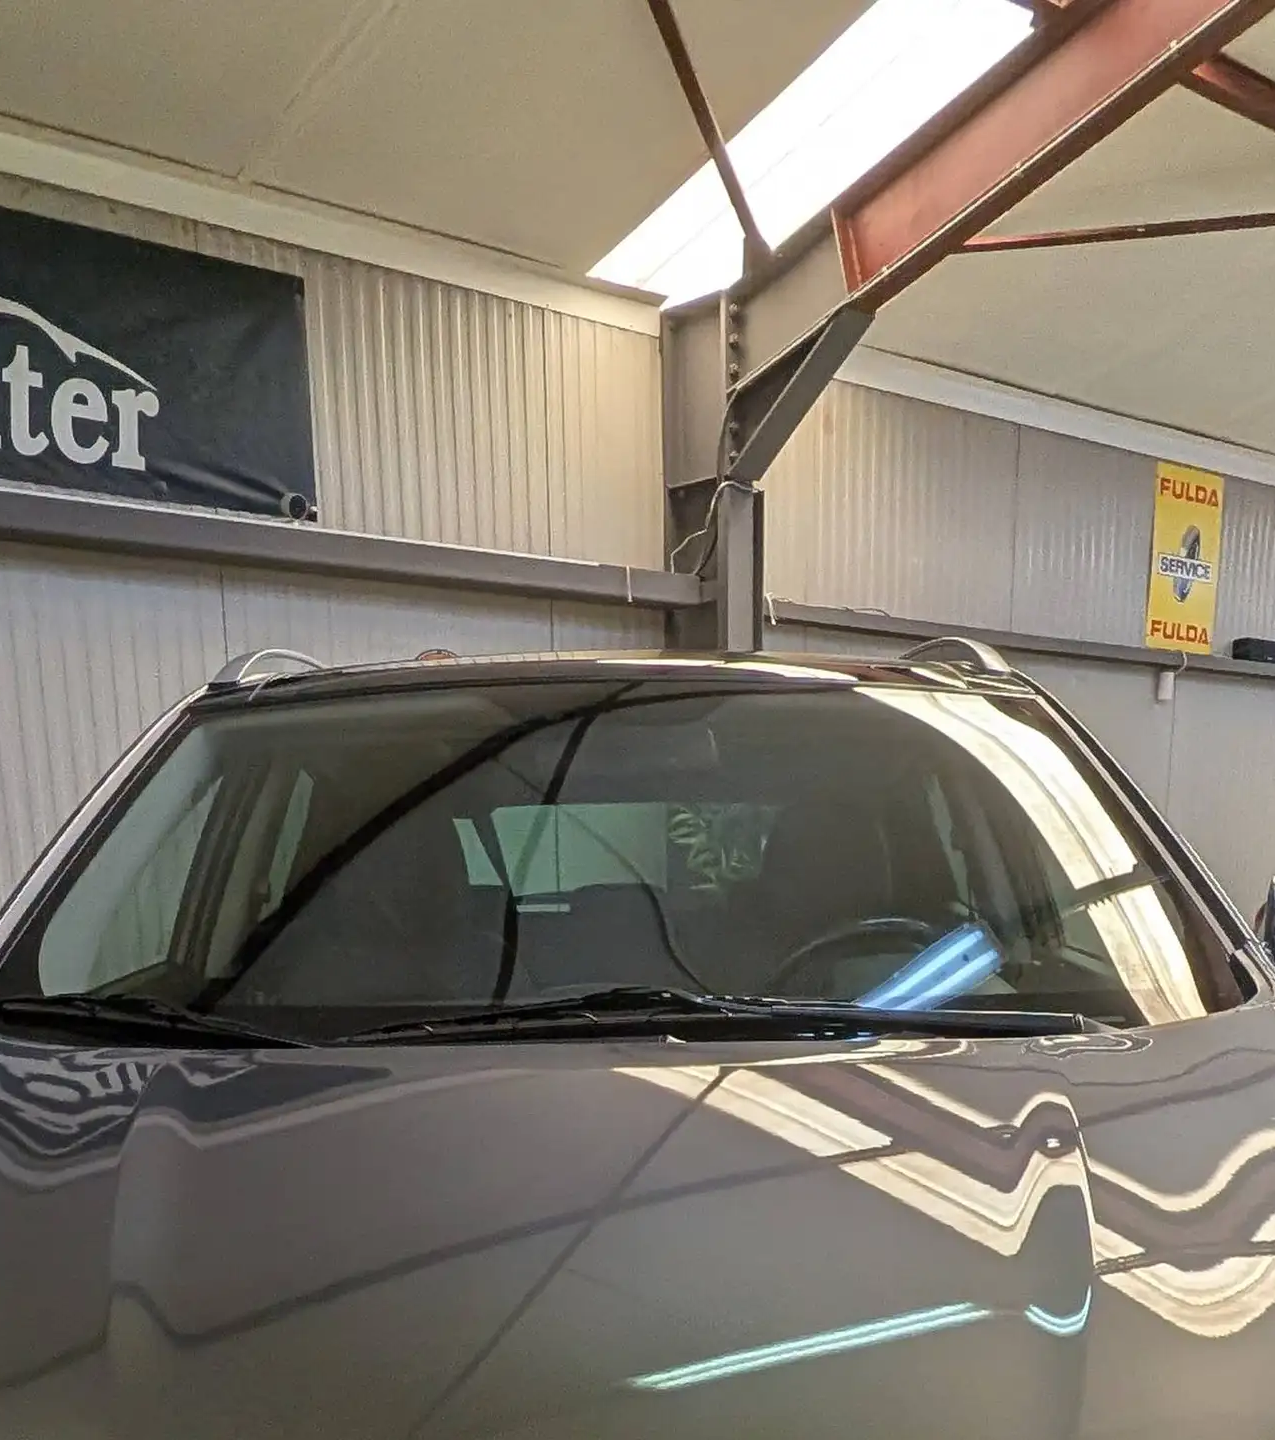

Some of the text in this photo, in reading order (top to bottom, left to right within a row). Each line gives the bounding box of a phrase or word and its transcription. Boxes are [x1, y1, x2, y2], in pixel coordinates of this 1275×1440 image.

[1159, 477, 1219, 507] FULDA
[1160, 556, 1211, 580] SERVICE
[1150, 619, 1210, 645] FULDA
